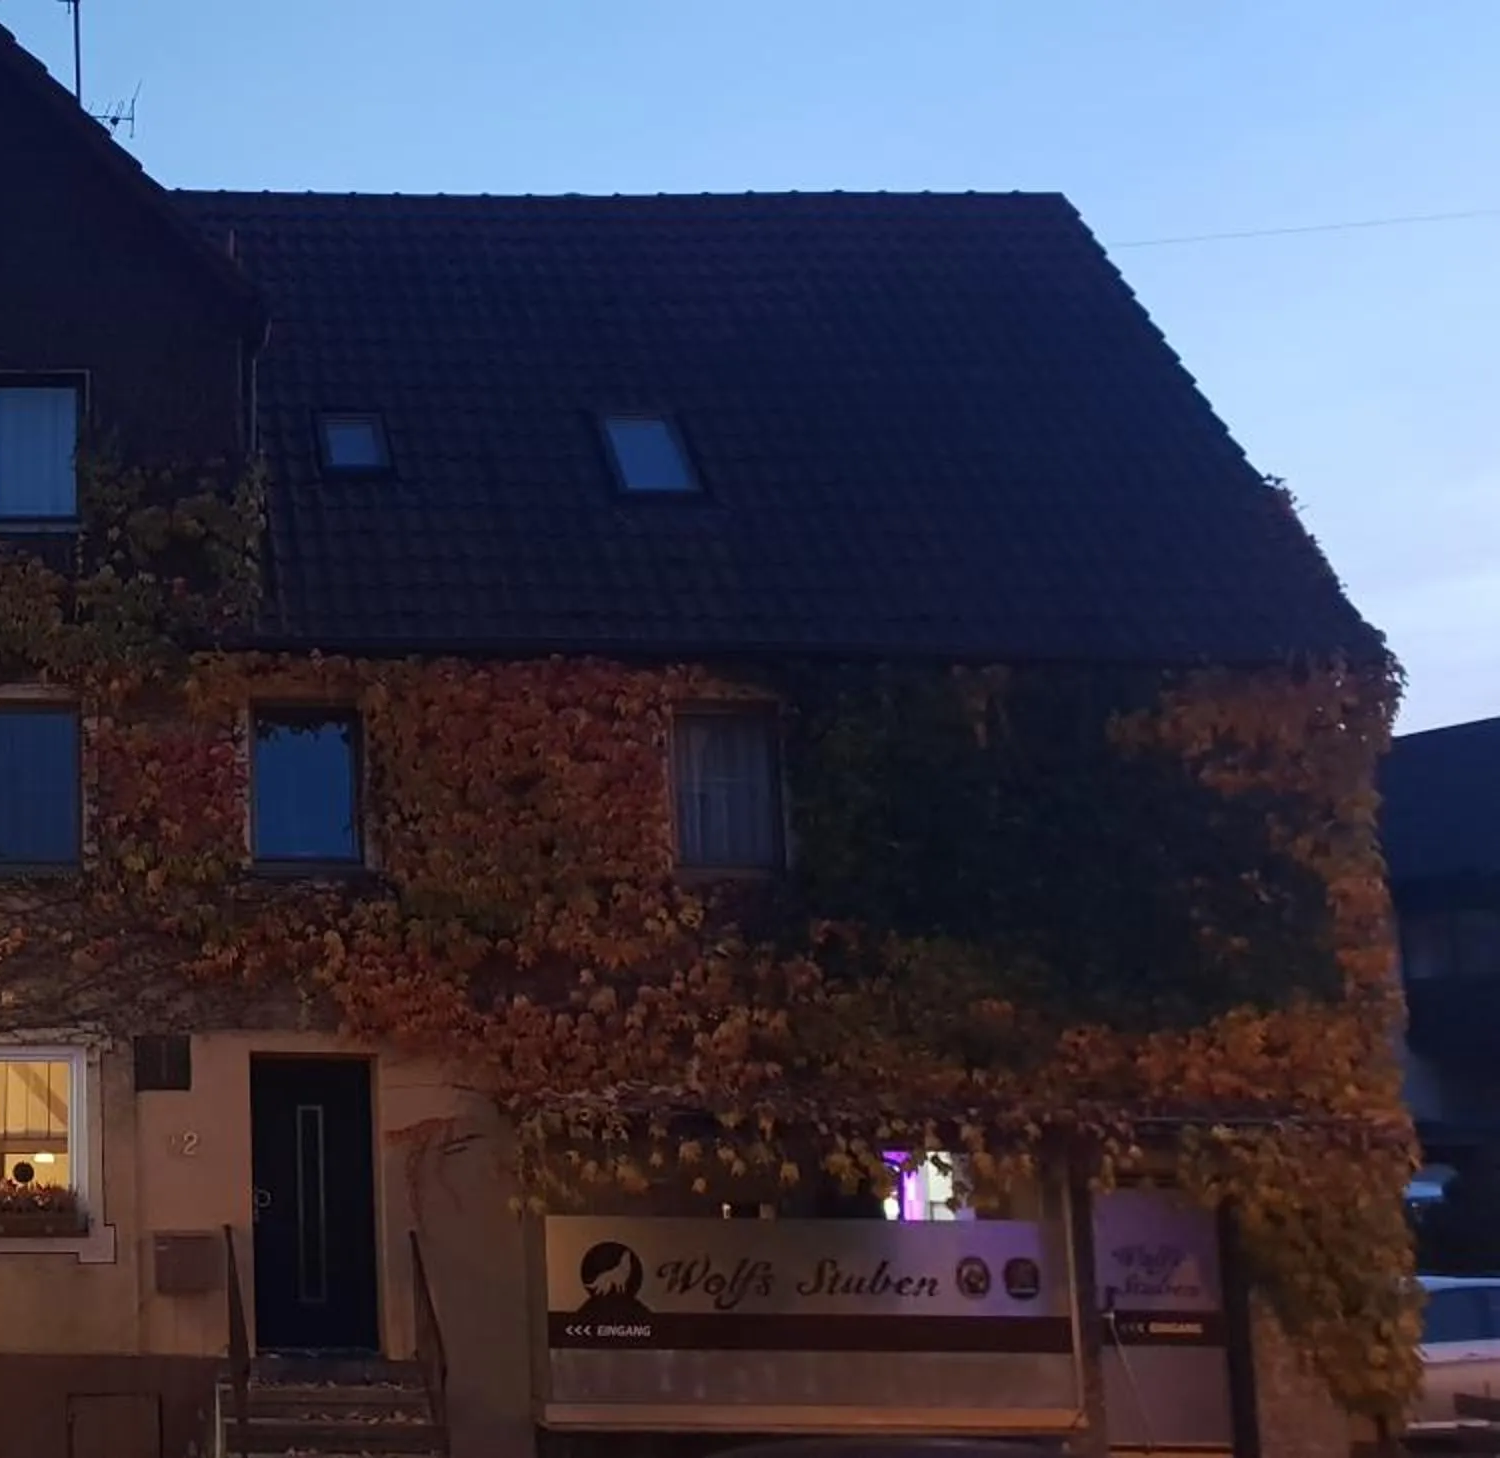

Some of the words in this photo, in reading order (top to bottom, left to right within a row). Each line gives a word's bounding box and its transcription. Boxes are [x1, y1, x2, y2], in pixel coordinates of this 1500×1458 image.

[656, 1254, 776, 1311] Wolfs
[797, 1258, 939, 1297] Stuben
[597, 1325, 651, 1337] EINGANG
